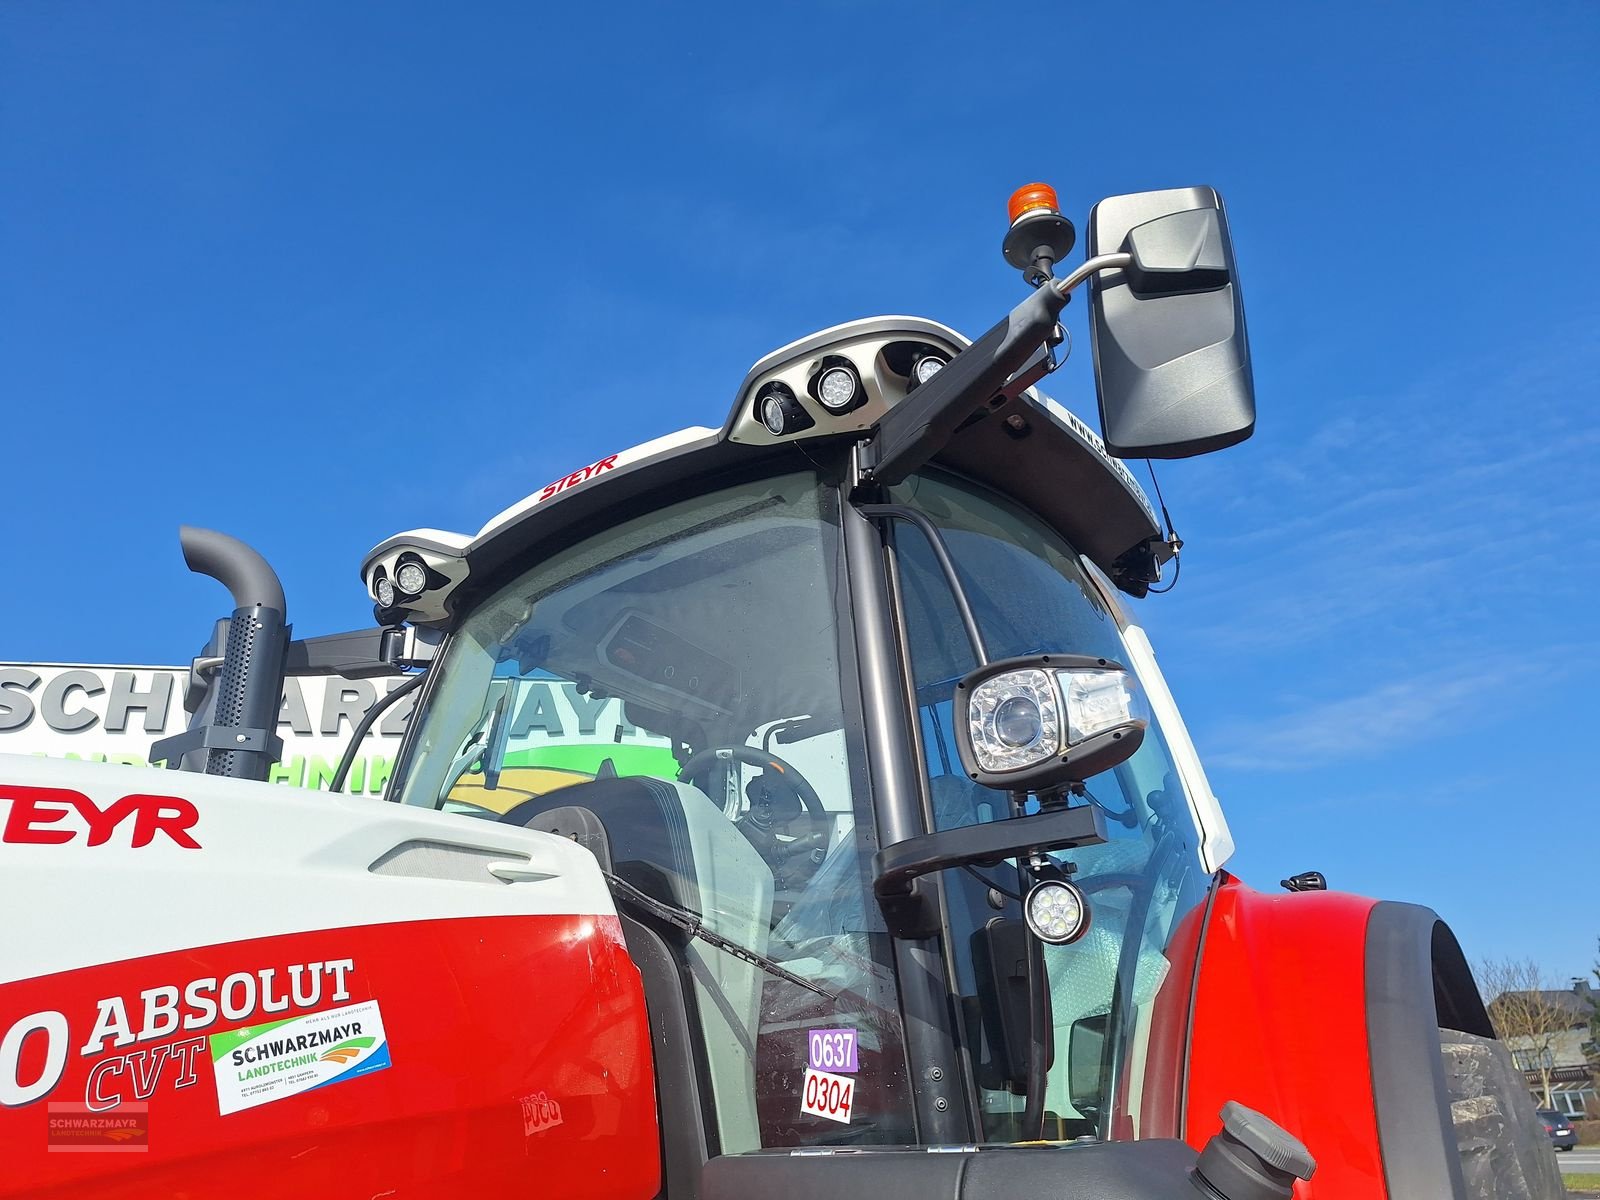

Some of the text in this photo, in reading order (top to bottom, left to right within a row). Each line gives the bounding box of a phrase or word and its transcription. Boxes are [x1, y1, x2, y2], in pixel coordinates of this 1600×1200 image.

[539, 455, 618, 501] STEYR
[0, 785, 203, 849] EYR
[81, 958, 354, 1056] ABSOLUT
[232, 1022, 362, 1066] SCHWARZMAYR
[811, 1033, 854, 1068] 0637
[85, 1036, 205, 1112] CVT
[238, 1052, 318, 1082] LANDTECHNIK
[806, 1075, 851, 1118] 0304
